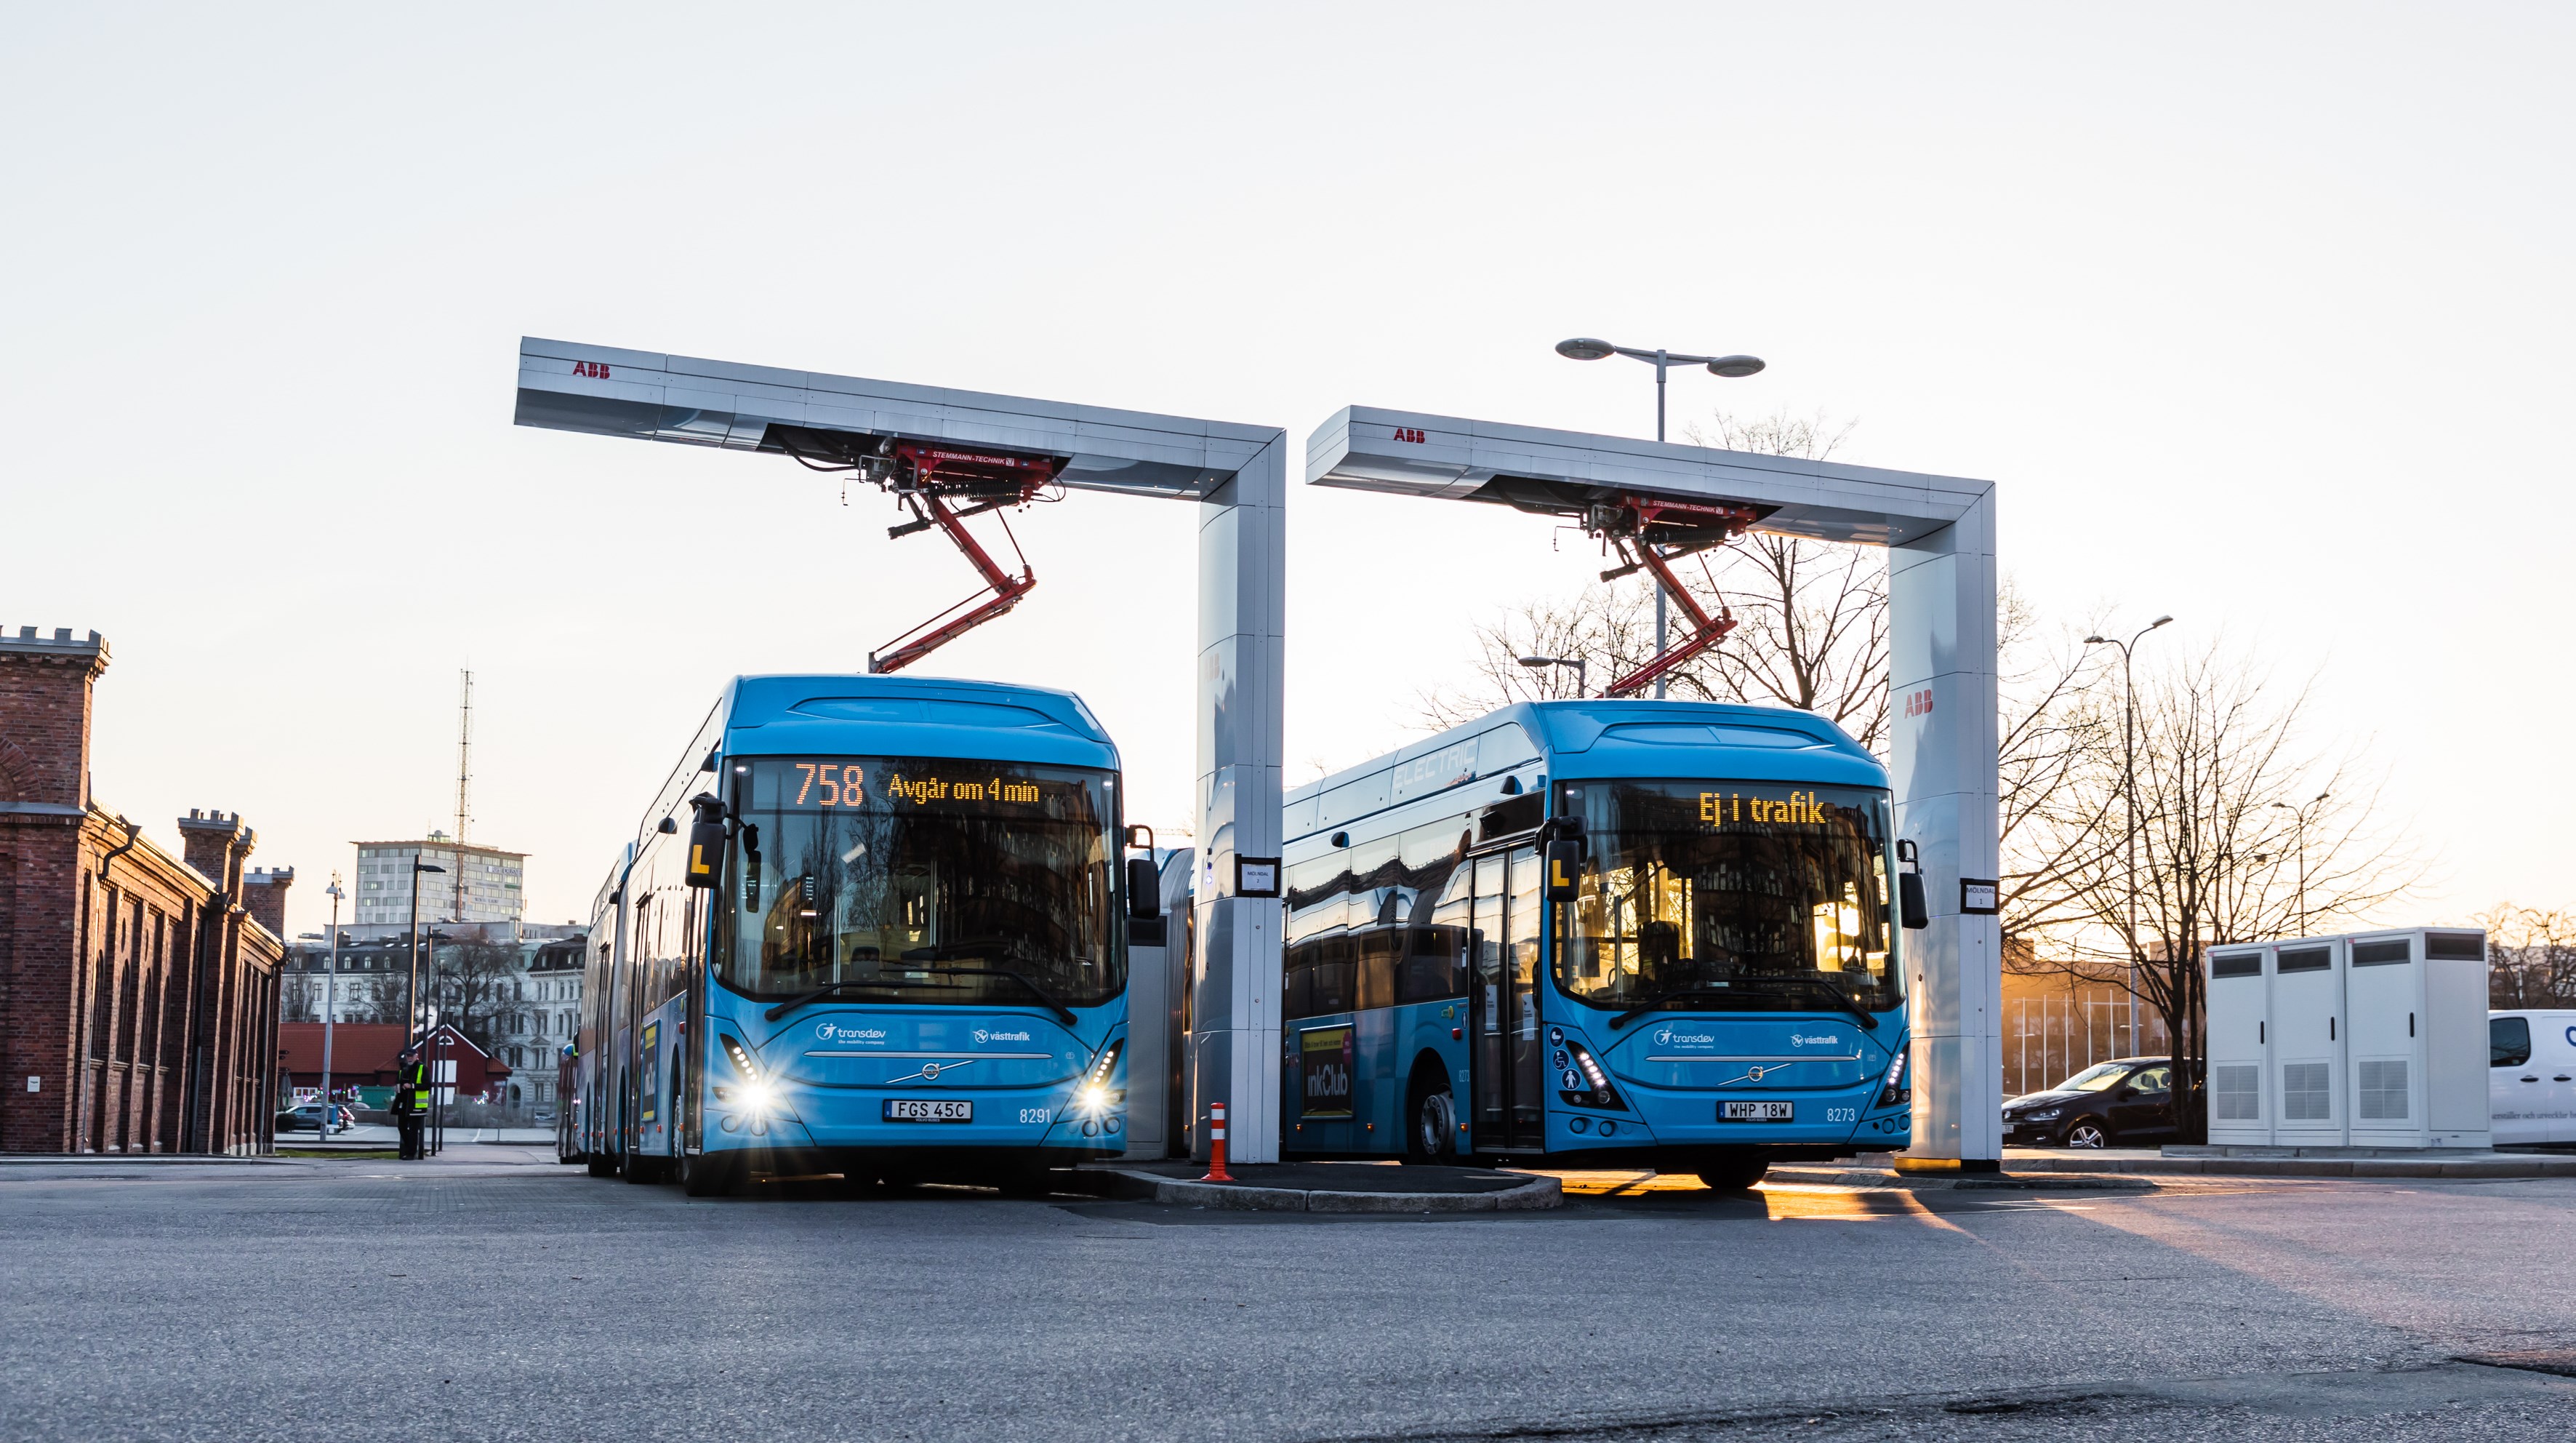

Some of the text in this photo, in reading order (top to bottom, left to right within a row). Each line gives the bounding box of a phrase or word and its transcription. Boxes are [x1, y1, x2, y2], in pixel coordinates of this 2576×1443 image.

[572, 361, 610, 379] ABB
[1394, 428, 1425, 444] ABB
[932, 451, 1005, 465] STEMMANN-TECHNIK
[1653, 500, 1716, 513] STEMMANN-TECHNIK
[1905, 689, 1933, 719] ABB
[1393, 739, 1477, 789] ELECTRIC
[796, 764, 1039, 807] 758 Avgår om 4 min
[1700, 791, 1826, 827] Ej i trafik
[691, 844, 710, 874] L
[1552, 860, 1569, 887] L
[1966, 887, 1995, 895] MÖLNDAL
[837, 1028, 886, 1039] transdev
[990, 1031, 1030, 1042] västtrafik
[1672, 1034, 1714, 1043] transdev
[1804, 1036, 1838, 1044] västtrafik
[1308, 1063, 1348, 1097] inkClub
[898, 1102, 965, 1117] FGS 45C
[1019, 1108, 1051, 1124] 8291
[1730, 1103, 1787, 1117] WHP 18W
[1827, 1108, 1855, 1122] 8273
